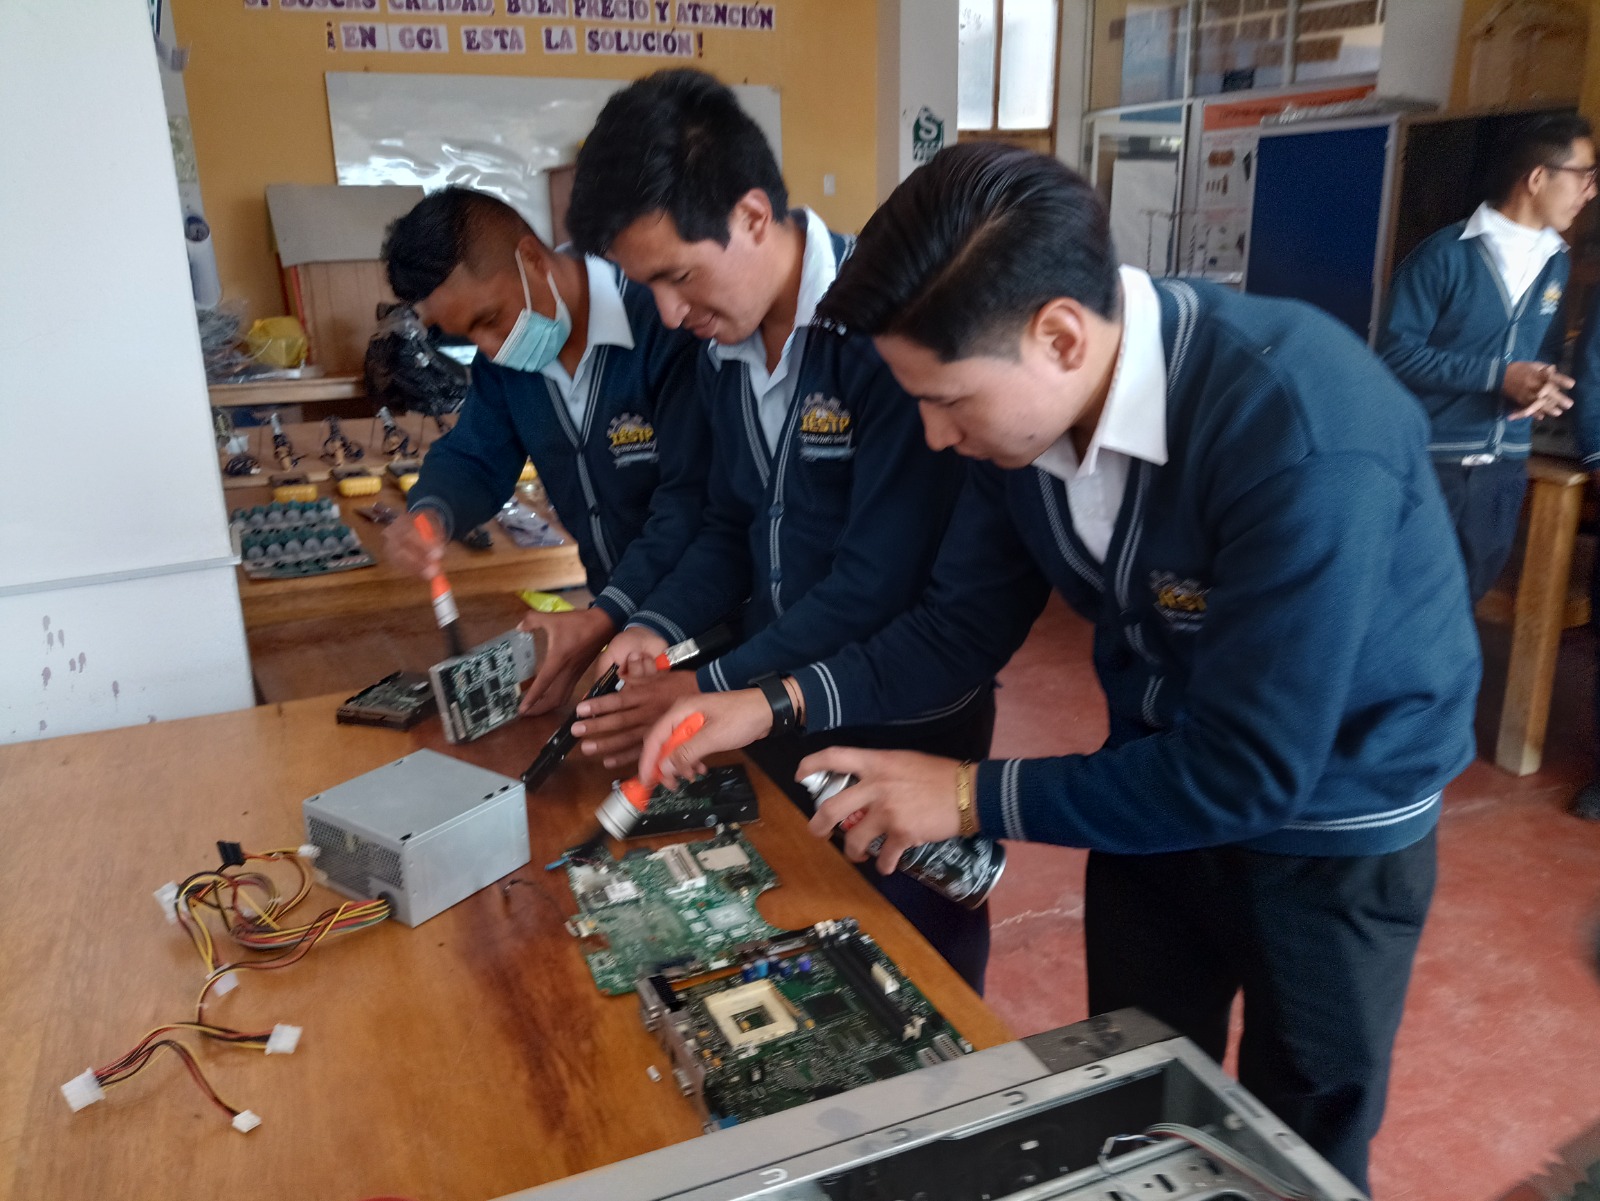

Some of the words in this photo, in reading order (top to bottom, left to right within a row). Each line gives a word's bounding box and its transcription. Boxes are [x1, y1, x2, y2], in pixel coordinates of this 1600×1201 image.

[574, 0, 649, 20] PRECIO
[655, 1, 669, 21] Y
[677, 1, 773, 30] ATENCIÓN
[464, 28, 524, 50] ESTA
[545, 28, 573, 49] LA
